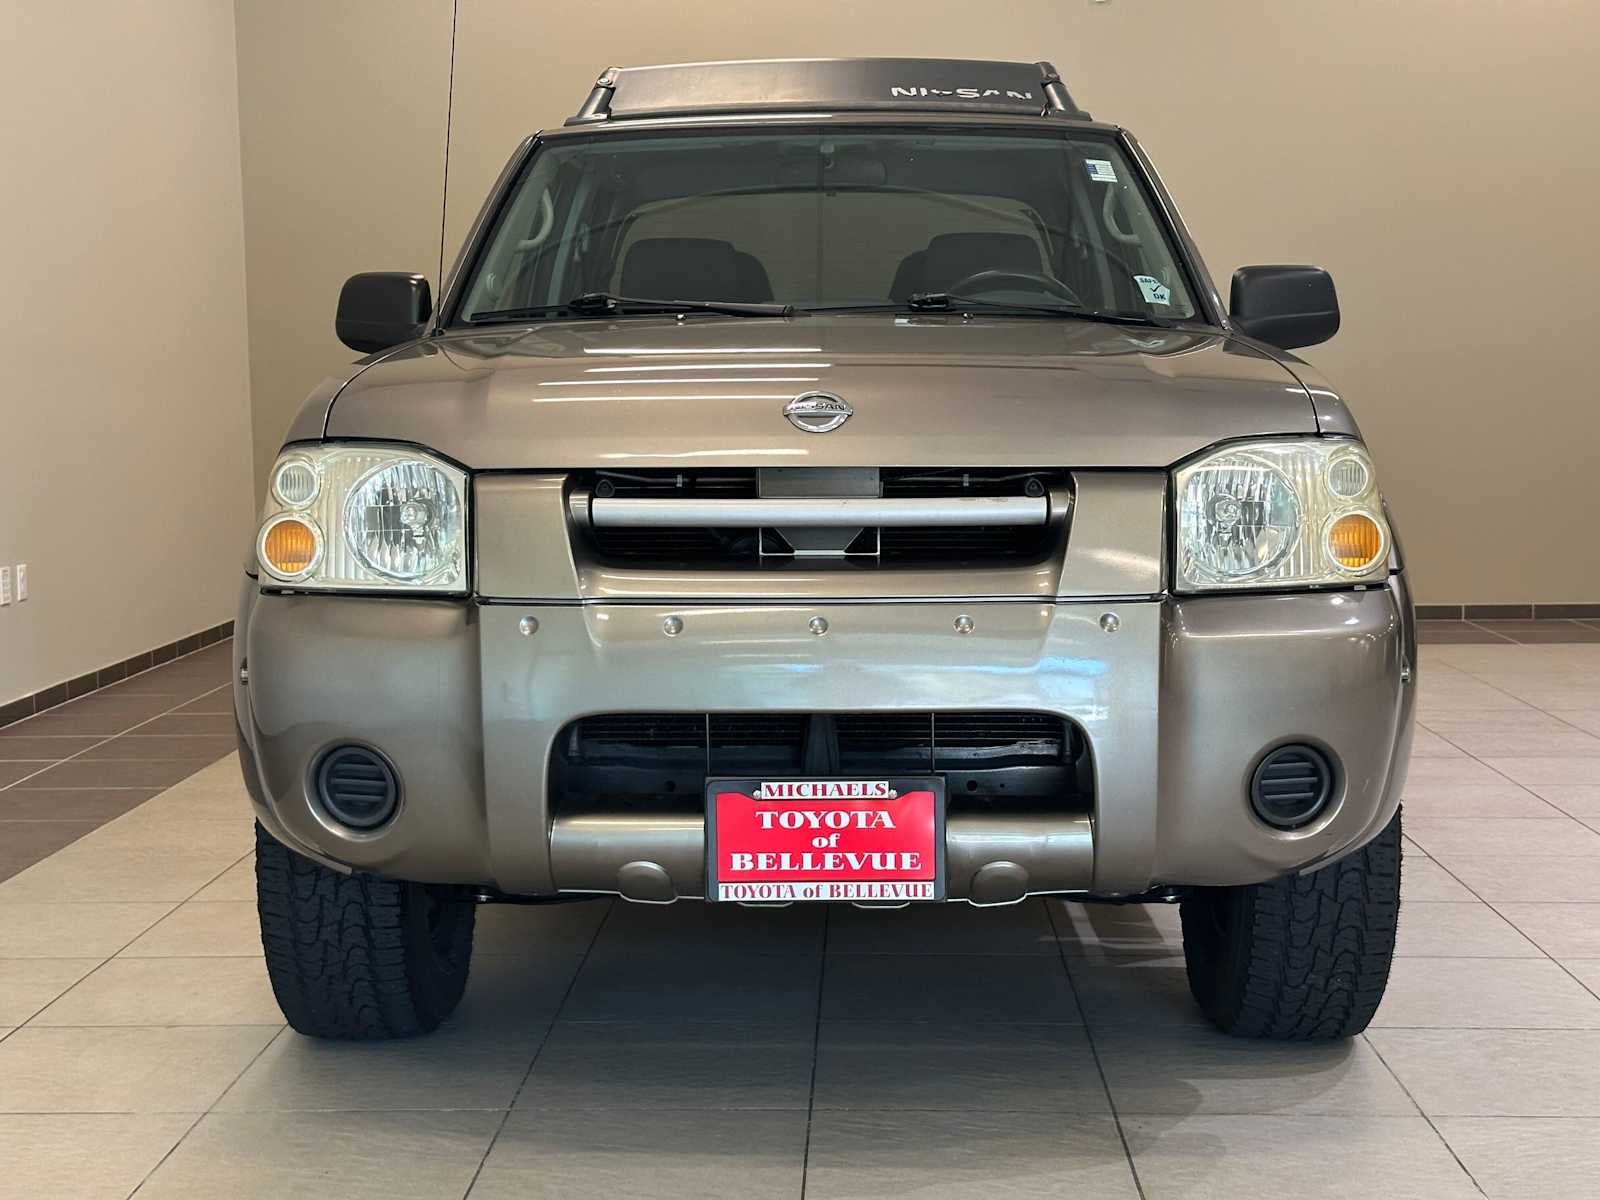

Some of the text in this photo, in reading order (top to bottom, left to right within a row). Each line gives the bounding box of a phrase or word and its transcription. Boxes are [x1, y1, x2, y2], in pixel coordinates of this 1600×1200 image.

[765, 783, 888, 797] MICHAELS
[755, 811, 896, 829] TOYOTA
[812, 833, 840, 848] of
[730, 852, 922, 871] BELLEVUE
[720, 883, 933, 899] TOYOTA of BELLEVUE
